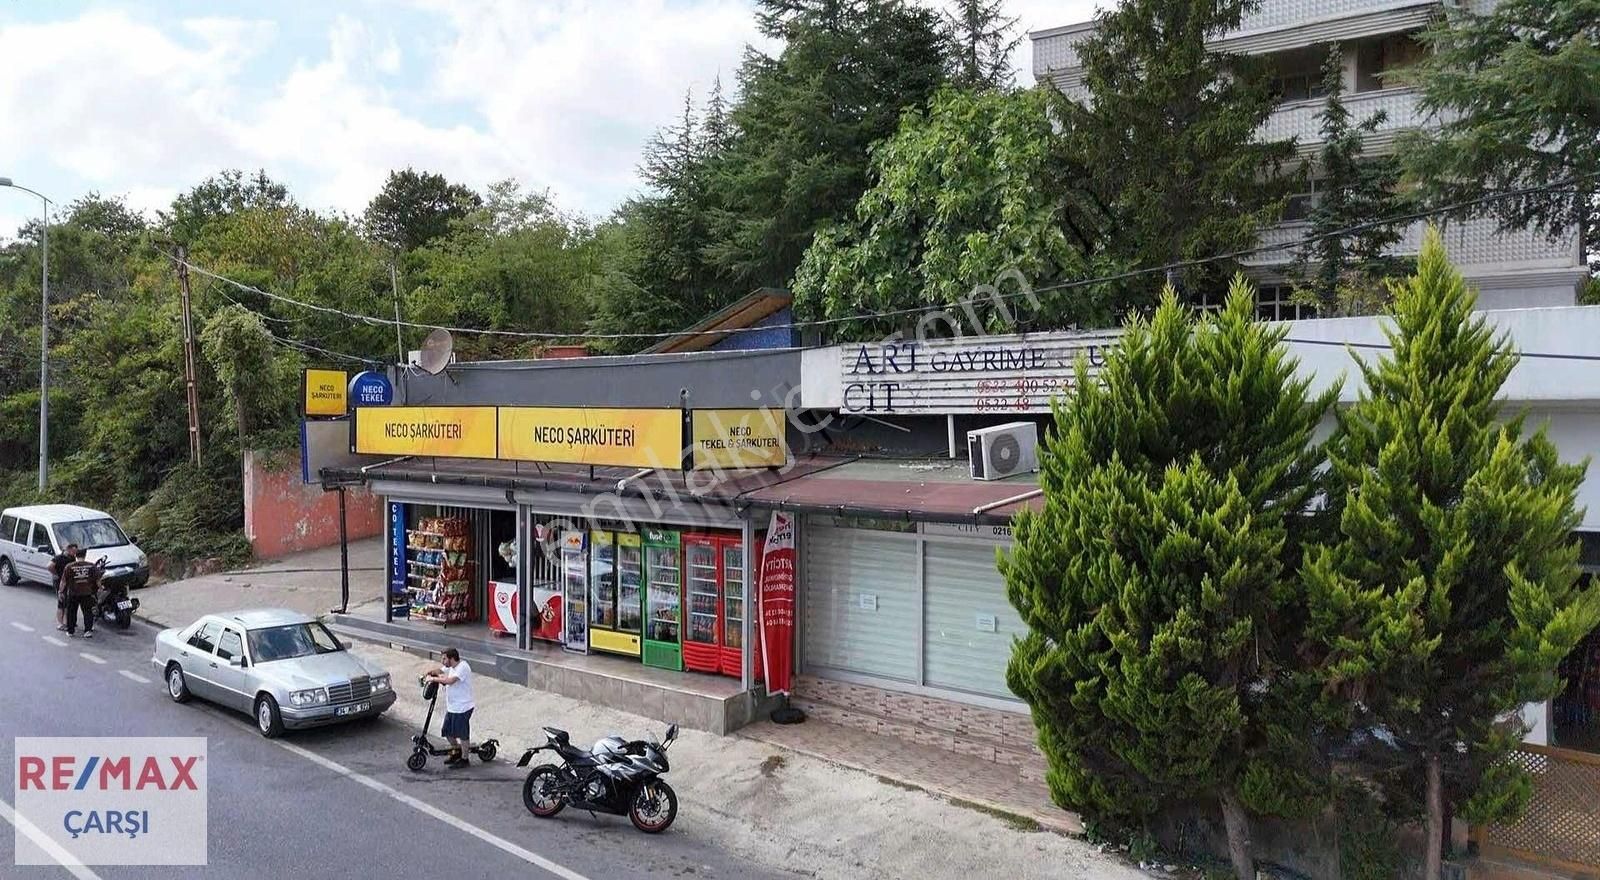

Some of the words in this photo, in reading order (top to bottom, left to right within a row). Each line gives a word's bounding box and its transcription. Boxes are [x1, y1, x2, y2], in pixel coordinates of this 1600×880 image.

[852, 345, 922, 373] ART
[362, 385, 384, 394] NECO
[360, 394, 385, 402] TEKEL
[385, 423, 408, 438] NECO
[410, 419, 463, 442] ŞARKÜTERİ
[729, 426, 752, 437] NECO
[534, 426, 564, 443] NECO
[567, 424, 635, 449] ŞARKÜTERİ
[700, 439, 727, 450] TEKEL
[993, 527, 1012, 536] 0216
